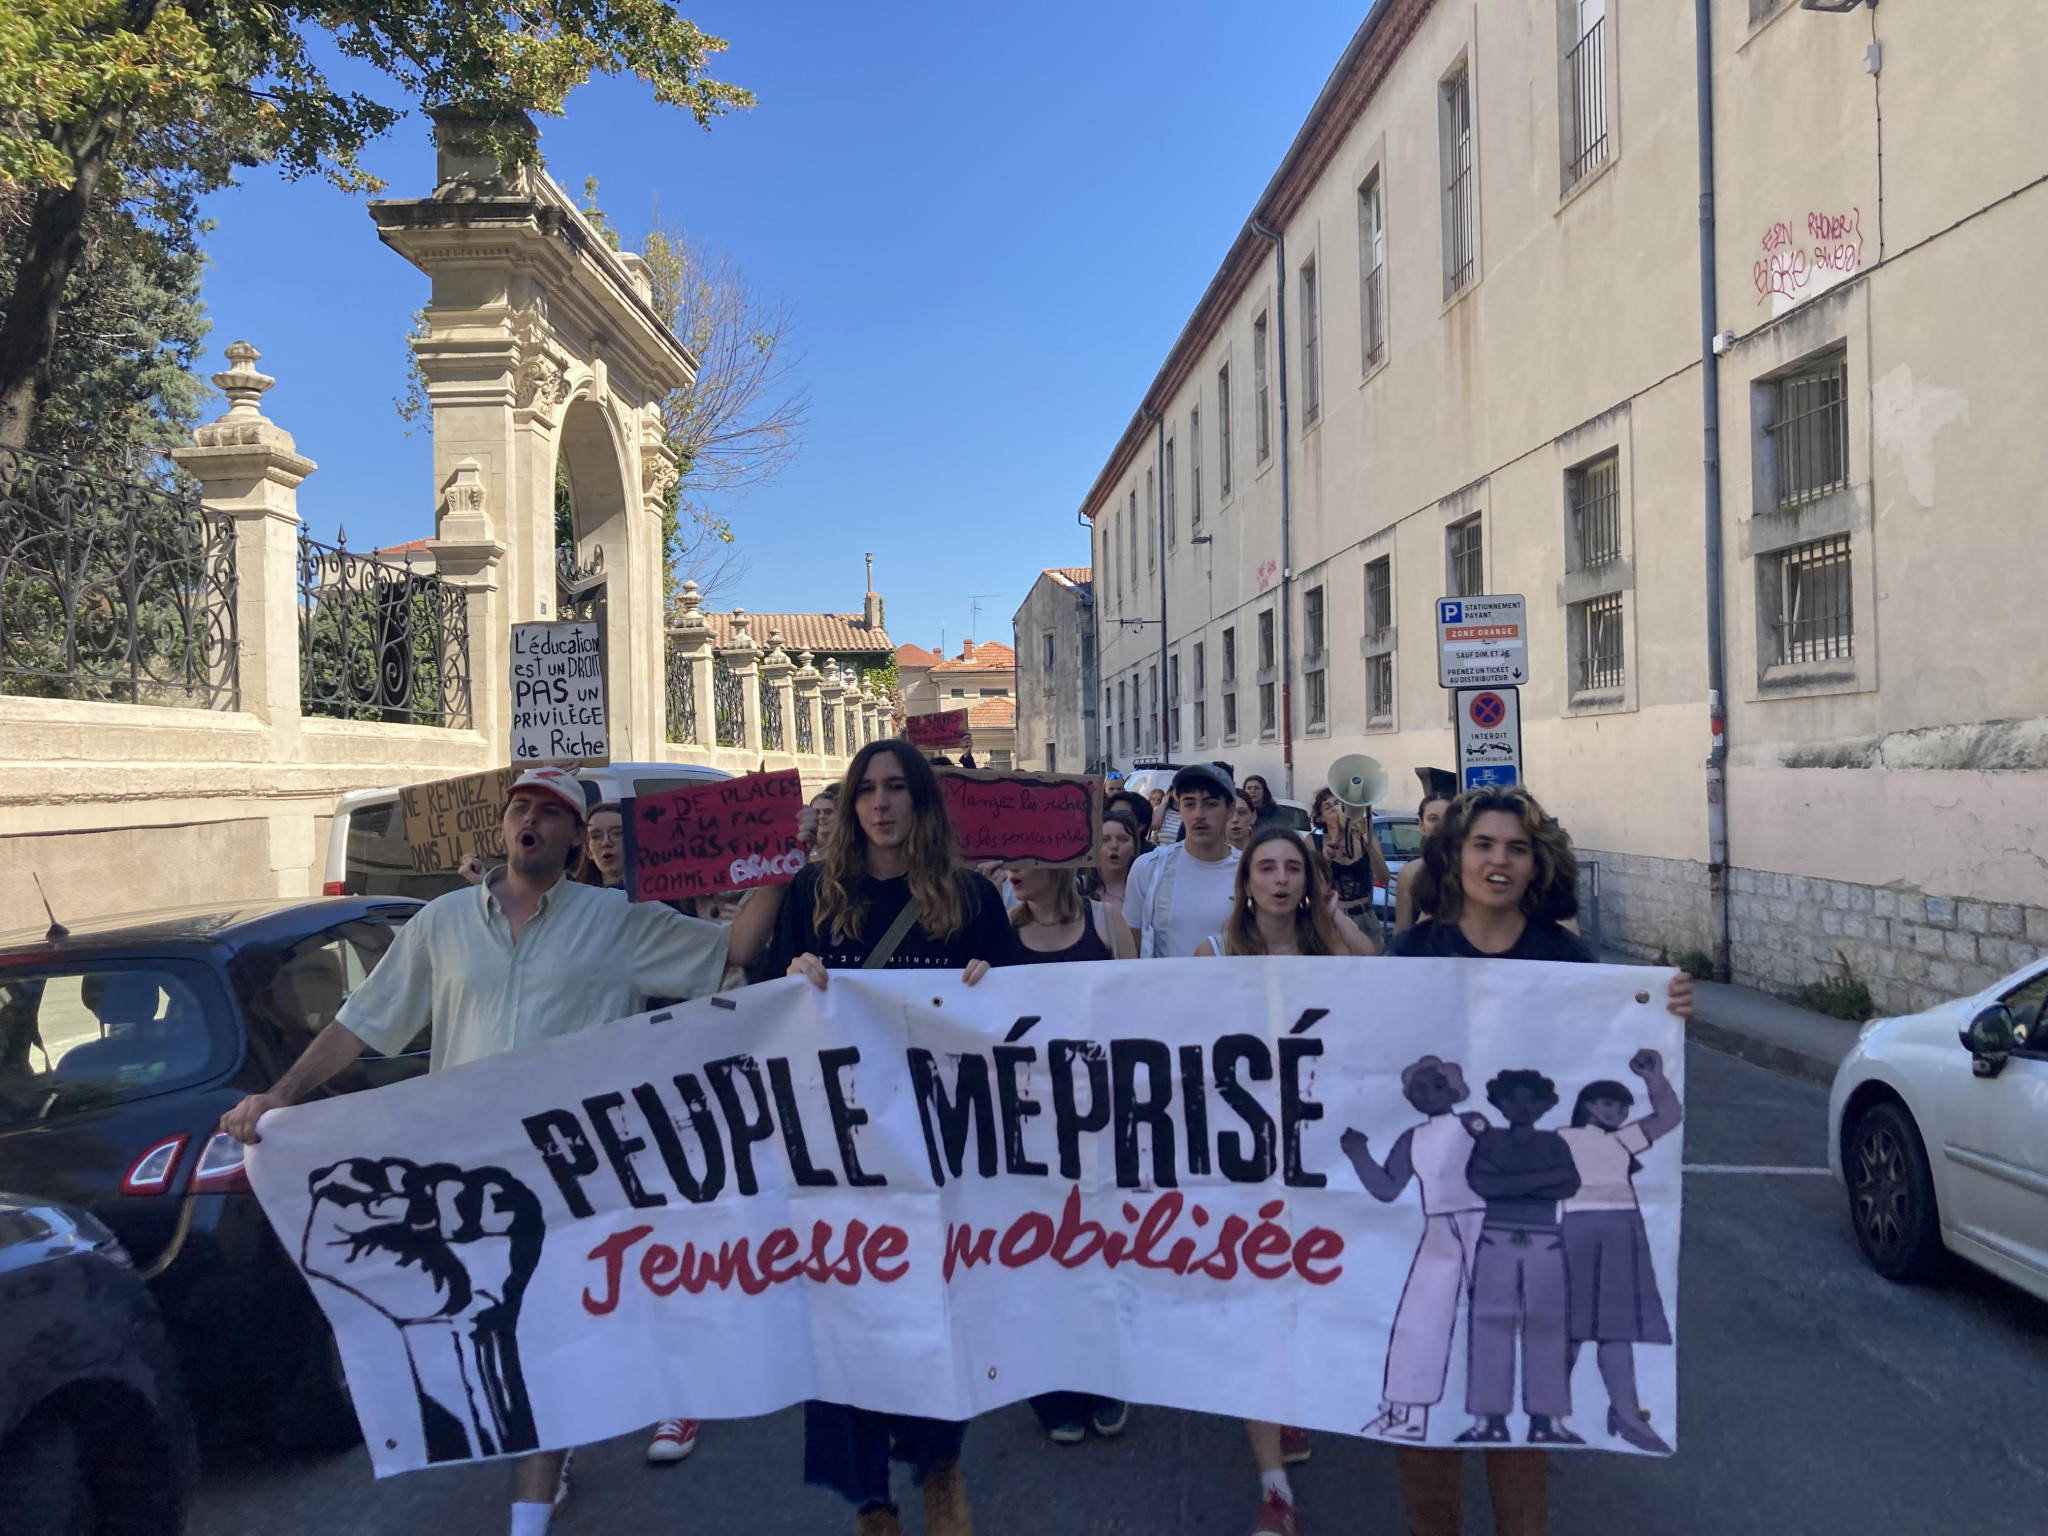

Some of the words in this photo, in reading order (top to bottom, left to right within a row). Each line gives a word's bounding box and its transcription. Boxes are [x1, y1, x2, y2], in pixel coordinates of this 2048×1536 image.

[1444, 604, 1459, 622] P
[1464, 602, 1521, 611] STATIONNEMENT
[515, 627, 599, 655] L'éducation
[1478, 628, 1513, 636] ORANGE
[568, 654, 600, 678] DROIT
[516, 677, 569, 708] PAS
[517, 736, 540, 758] de
[551, 728, 605, 757] Riche
[1471, 732, 1507, 740] INTERDIT
[400, 787, 421, 819] NE
[426, 774, 488, 815] REMUEZ
[672, 793, 706, 816] DE
[720, 777, 801, 806] PLACES
[945, 780, 1015, 818] Mangez
[1020, 789, 1037, 810] les
[428, 814, 447, 839] LE
[456, 804, 504, 833] COUTEA
[731, 807, 773, 828] FAC
[410, 840, 442, 874] DANS
[448, 836, 464, 867] LA
[642, 870, 708, 894] COMME
[521, 1045, 888, 1219] PEUPLE
[906, 1008, 1330, 1188] MÉPRISÉ
[582, 1218, 910, 1316] Jeunesse
[942, 1183, 1345, 1285] mobilisée
